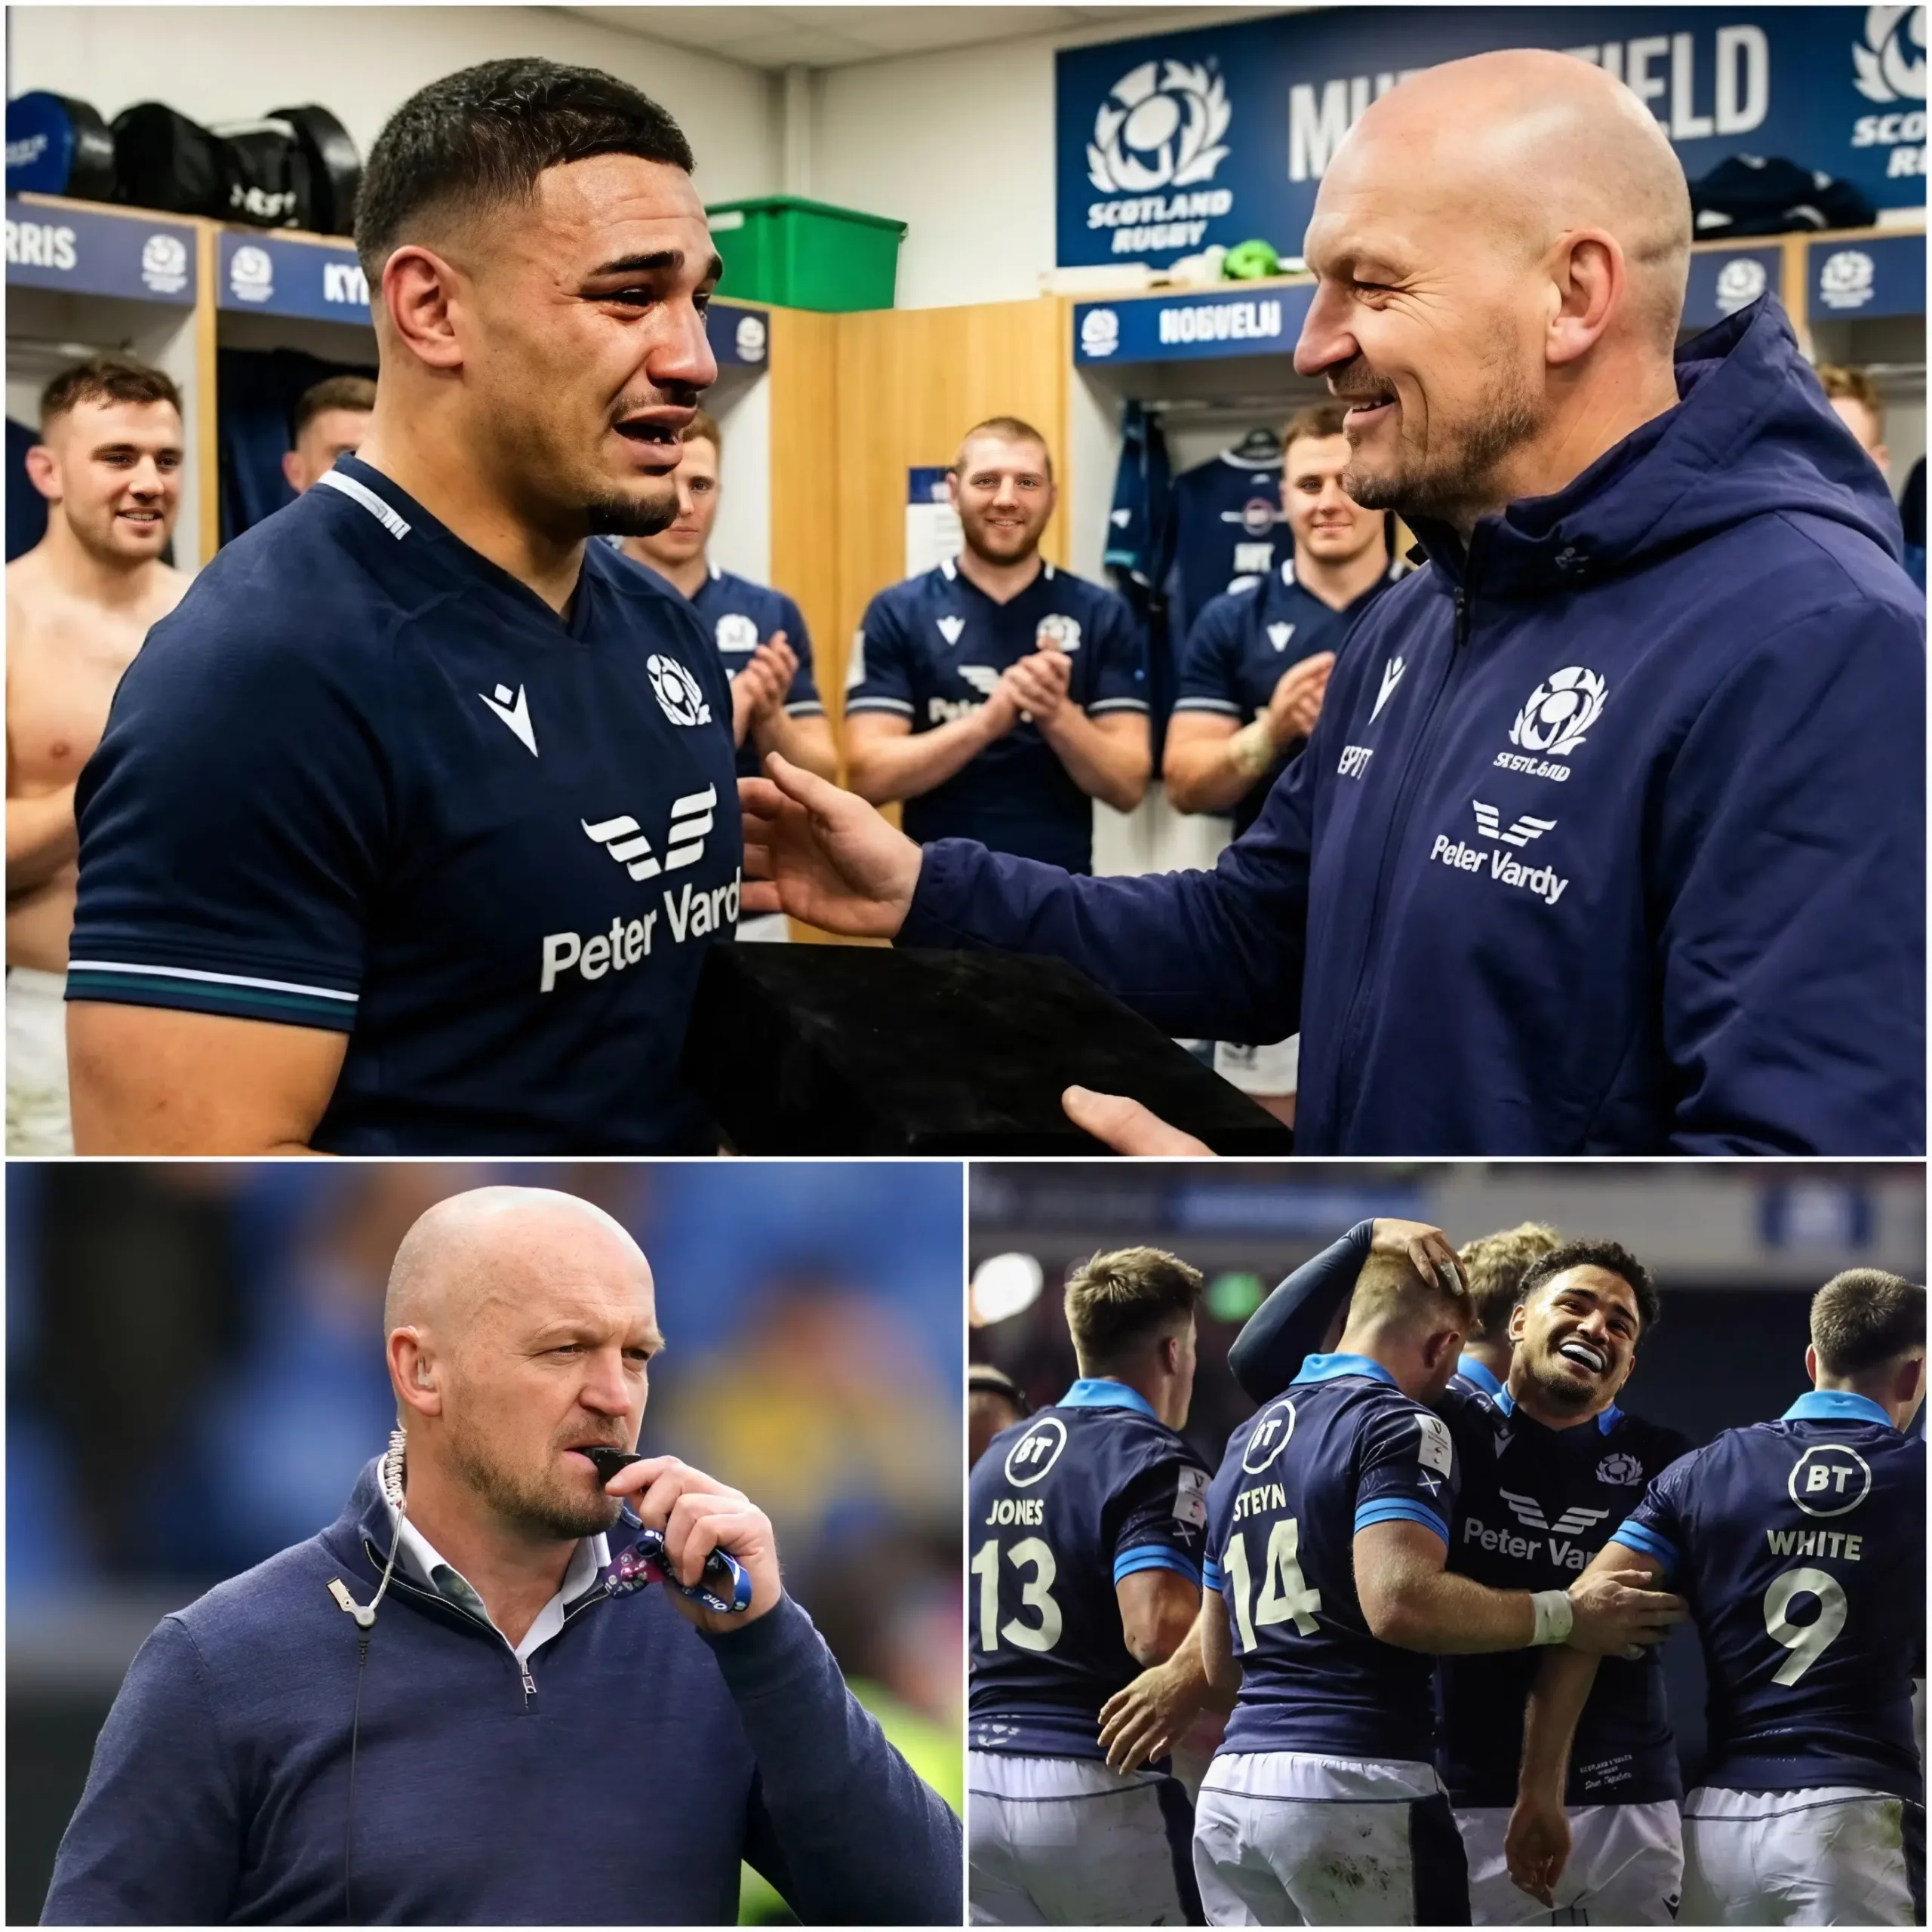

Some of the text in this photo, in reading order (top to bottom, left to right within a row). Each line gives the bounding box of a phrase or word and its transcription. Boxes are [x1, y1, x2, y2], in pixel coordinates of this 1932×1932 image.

[1087, 189, 1232, 229] SCOTLAND
[1112, 219, 1208, 254] RUGBY
[1491, 850, 1569, 905] Vardy
[540, 909, 657, 993] Peter
[1015, 1437, 1053, 1464] BT
[1251, 1418, 1281, 1452] BT
[1805, 1465, 1853, 1494] BT
[986, 1499, 1044, 1526] JONES
[1232, 1483, 1287, 1522] STEYN
[1463, 1517, 1542, 1561] Peter
[1767, 1530, 1863, 1561] WHITE
[971, 1537, 1063, 1652] 13
[1223, 1518, 1322, 1654] 14
[1764, 1567, 1848, 1687] 9
